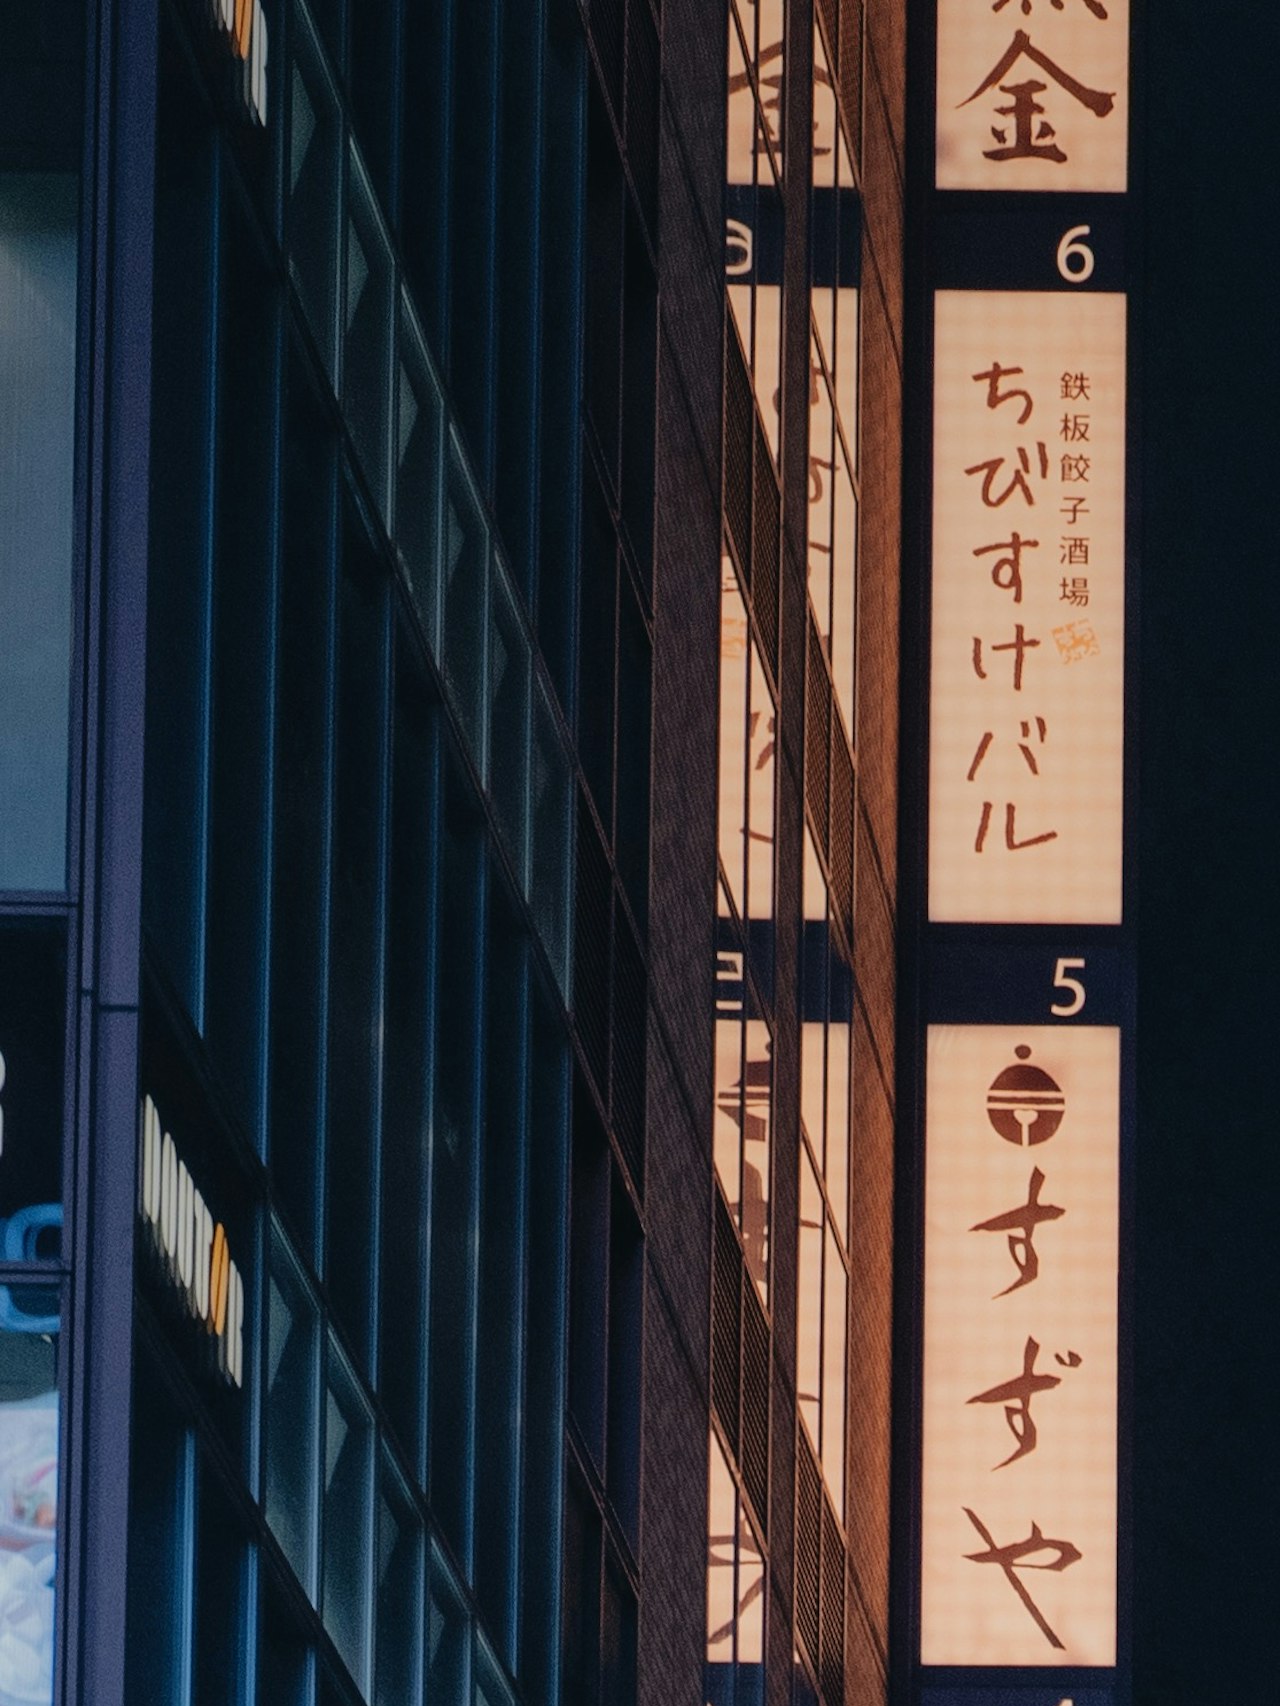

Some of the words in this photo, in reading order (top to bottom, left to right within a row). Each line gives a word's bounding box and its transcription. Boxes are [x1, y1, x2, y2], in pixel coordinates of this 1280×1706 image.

[955, 0, 1118, 163] 金
[1056, 226, 1095, 283] 6
[1058, 370, 1092, 607] 鉄板餃子酒場
[964, 361, 1058, 853] ちびすけバル
[1049, 957, 1087, 1017] 5
[960, 1165, 1084, 1652] すずや
